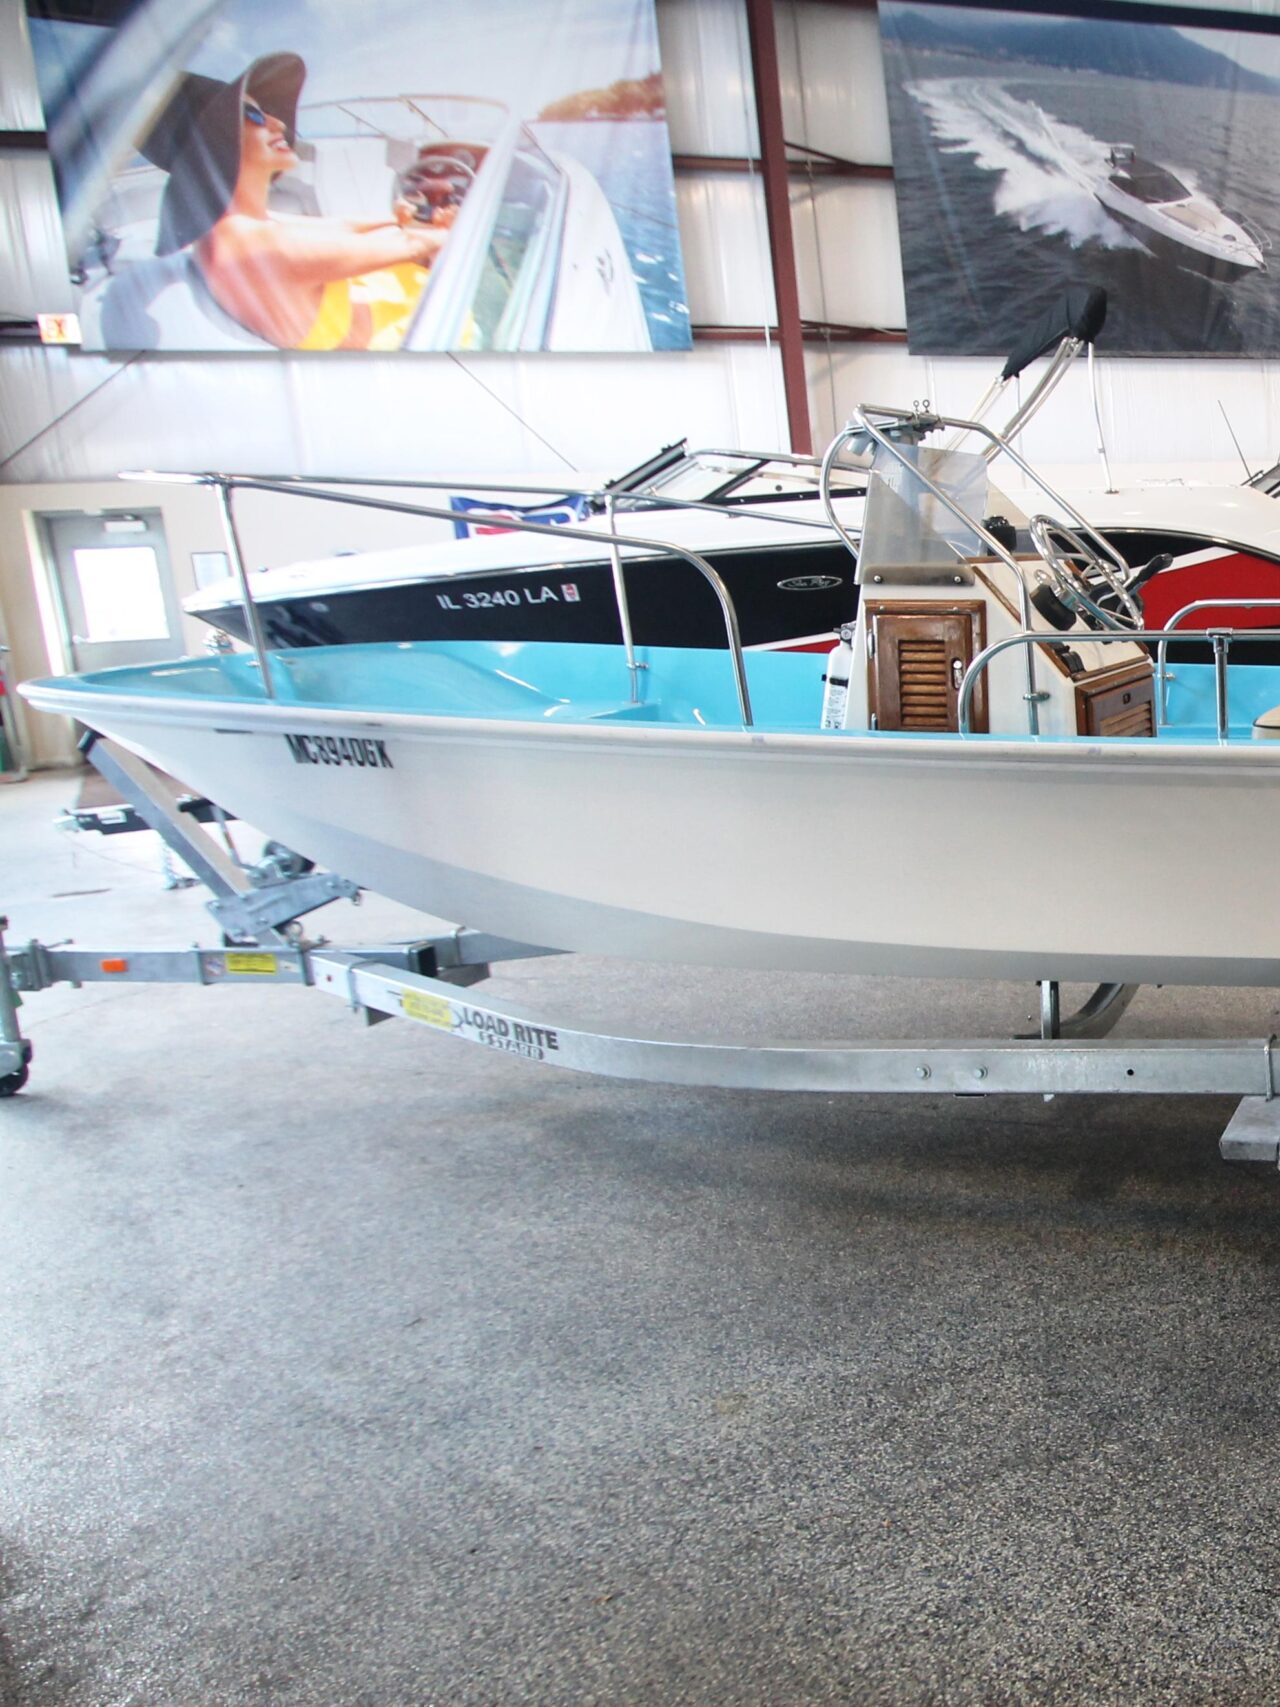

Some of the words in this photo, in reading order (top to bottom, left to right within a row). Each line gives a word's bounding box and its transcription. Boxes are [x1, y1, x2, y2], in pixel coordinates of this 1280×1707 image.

[436, 594, 463, 610] IL
[462, 589, 520, 608] 3240
[523, 586, 560, 604] LA
[463, 1007, 510, 1037] LOAD
[512, 1023, 559, 1050] RITE
